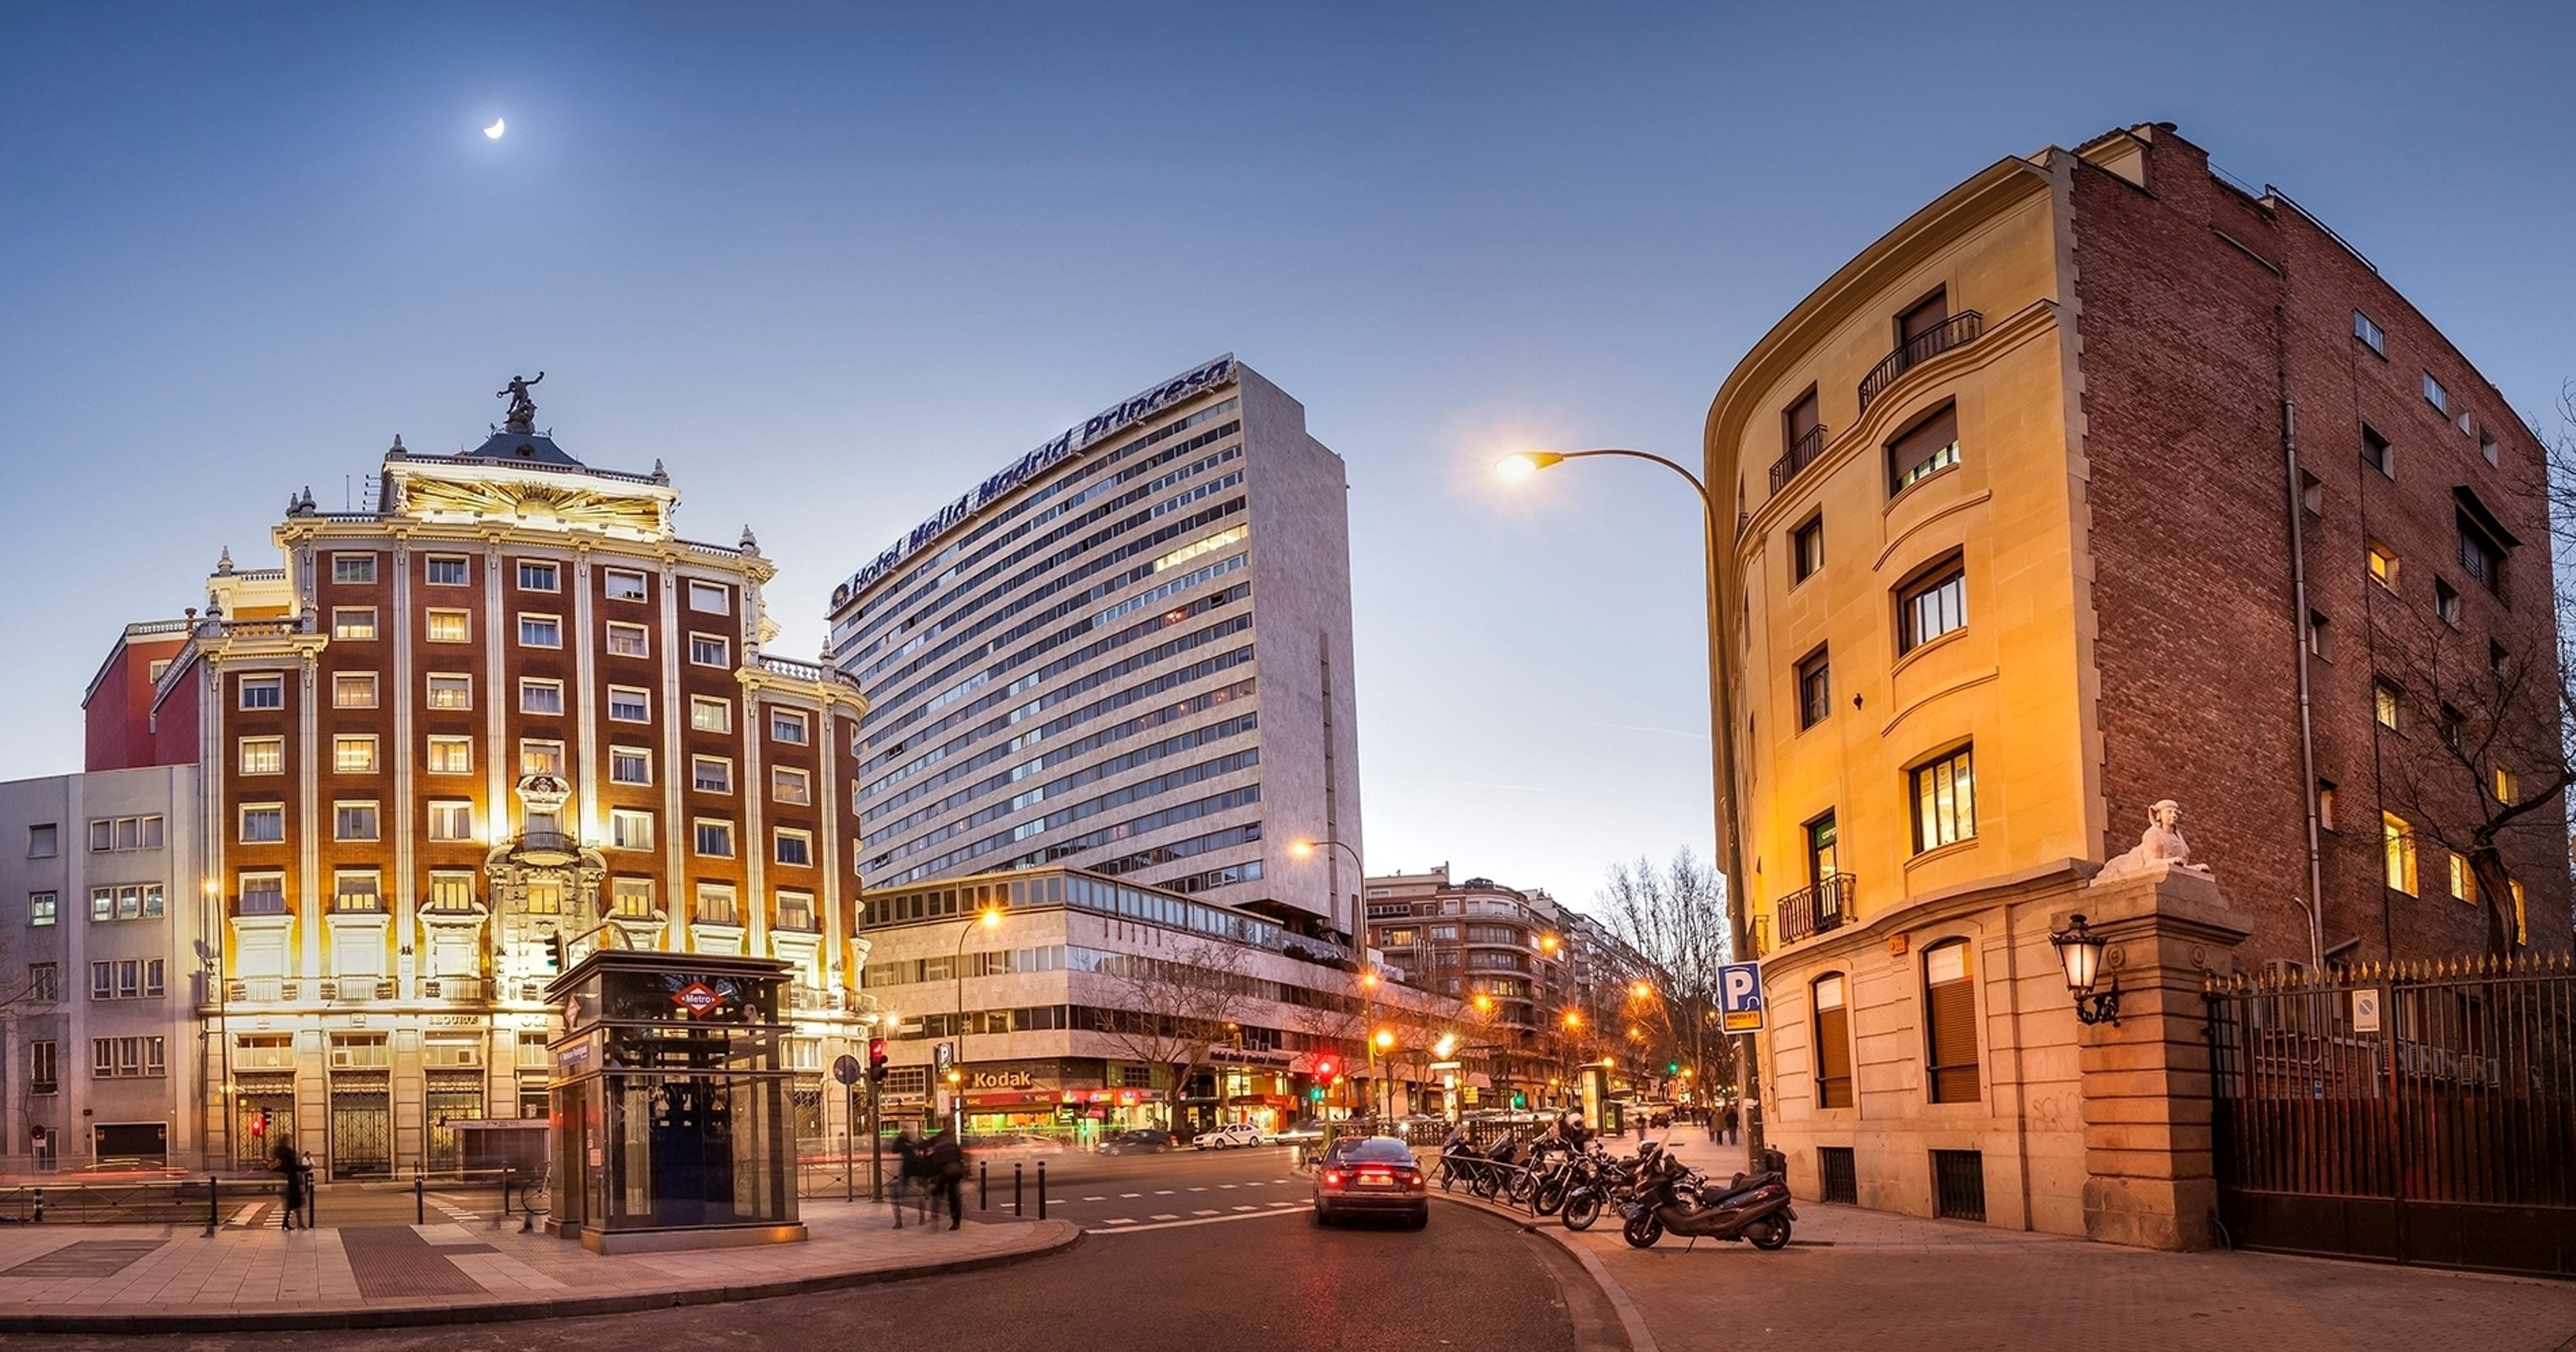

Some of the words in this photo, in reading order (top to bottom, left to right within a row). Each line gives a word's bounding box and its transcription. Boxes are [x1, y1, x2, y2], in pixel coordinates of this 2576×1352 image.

[852, 537, 902, 596] Hotel
[976, 427, 1072, 508] Madrid
[1082, 359, 1229, 443] Princesa
[685, 993, 711, 1004] Metro
[1725, 971, 1753, 1010] P
[974, 1071, 1031, 1088] Kodak
